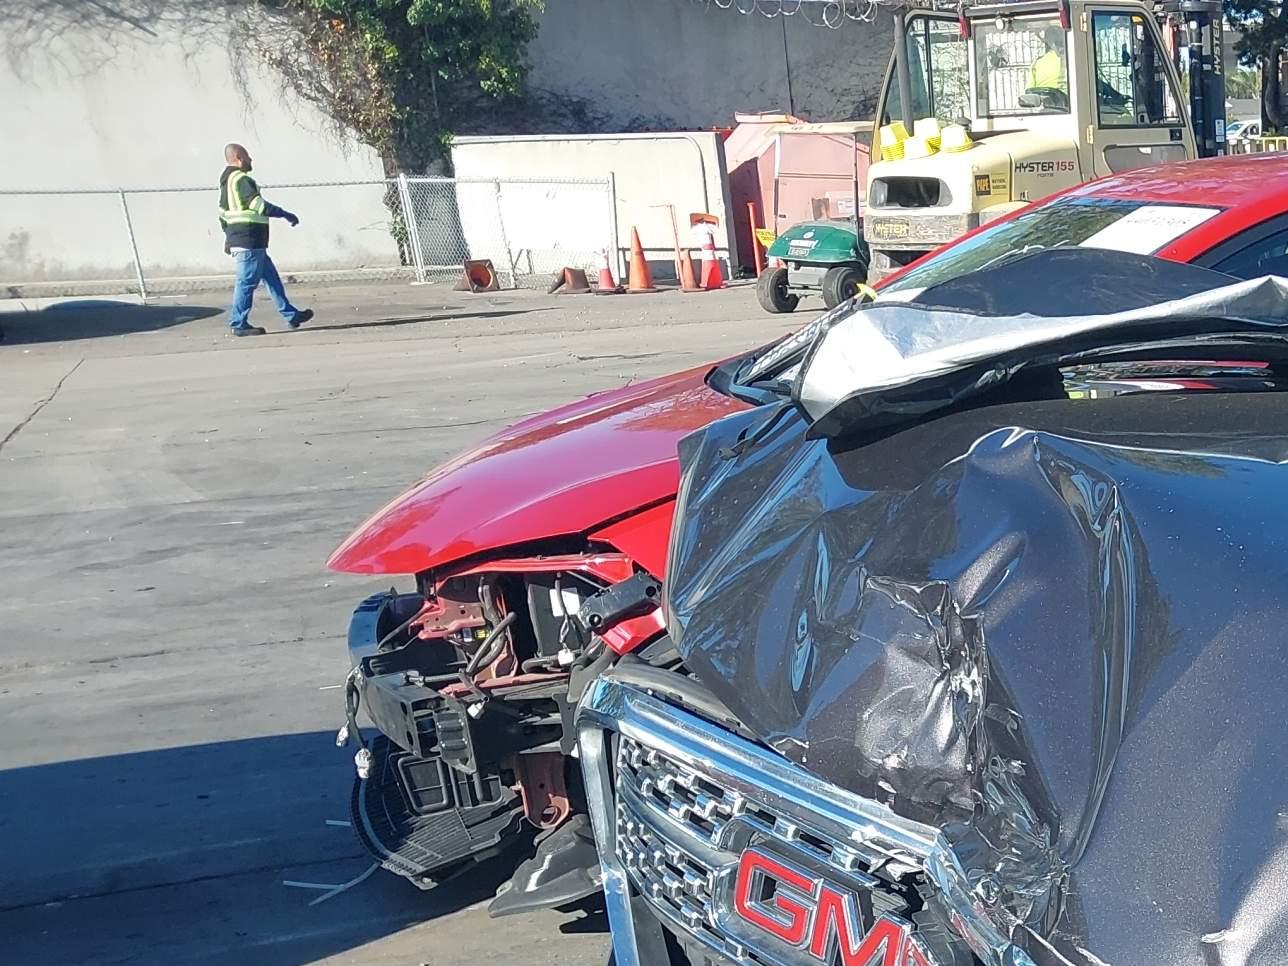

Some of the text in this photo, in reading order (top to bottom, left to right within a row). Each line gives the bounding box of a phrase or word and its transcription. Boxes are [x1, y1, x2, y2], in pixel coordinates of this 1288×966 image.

[1213, 18, 1222, 75] HYSTER
[1014, 161, 1075, 173] HYSTER 155
